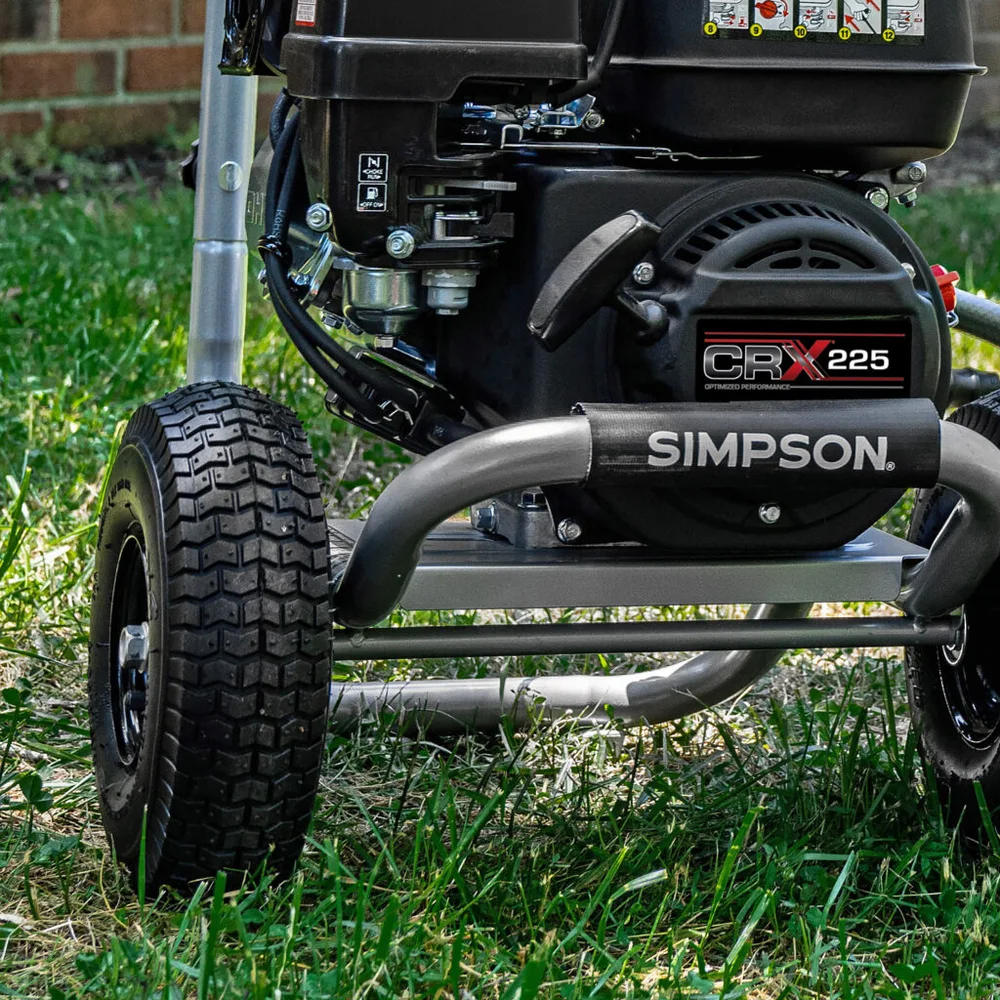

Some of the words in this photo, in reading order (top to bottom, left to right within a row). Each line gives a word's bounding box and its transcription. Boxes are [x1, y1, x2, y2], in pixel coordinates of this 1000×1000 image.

[796, 28, 805, 36] 10
[703, 340, 831, 380] CRX
[828, 349, 889, 370] 225
